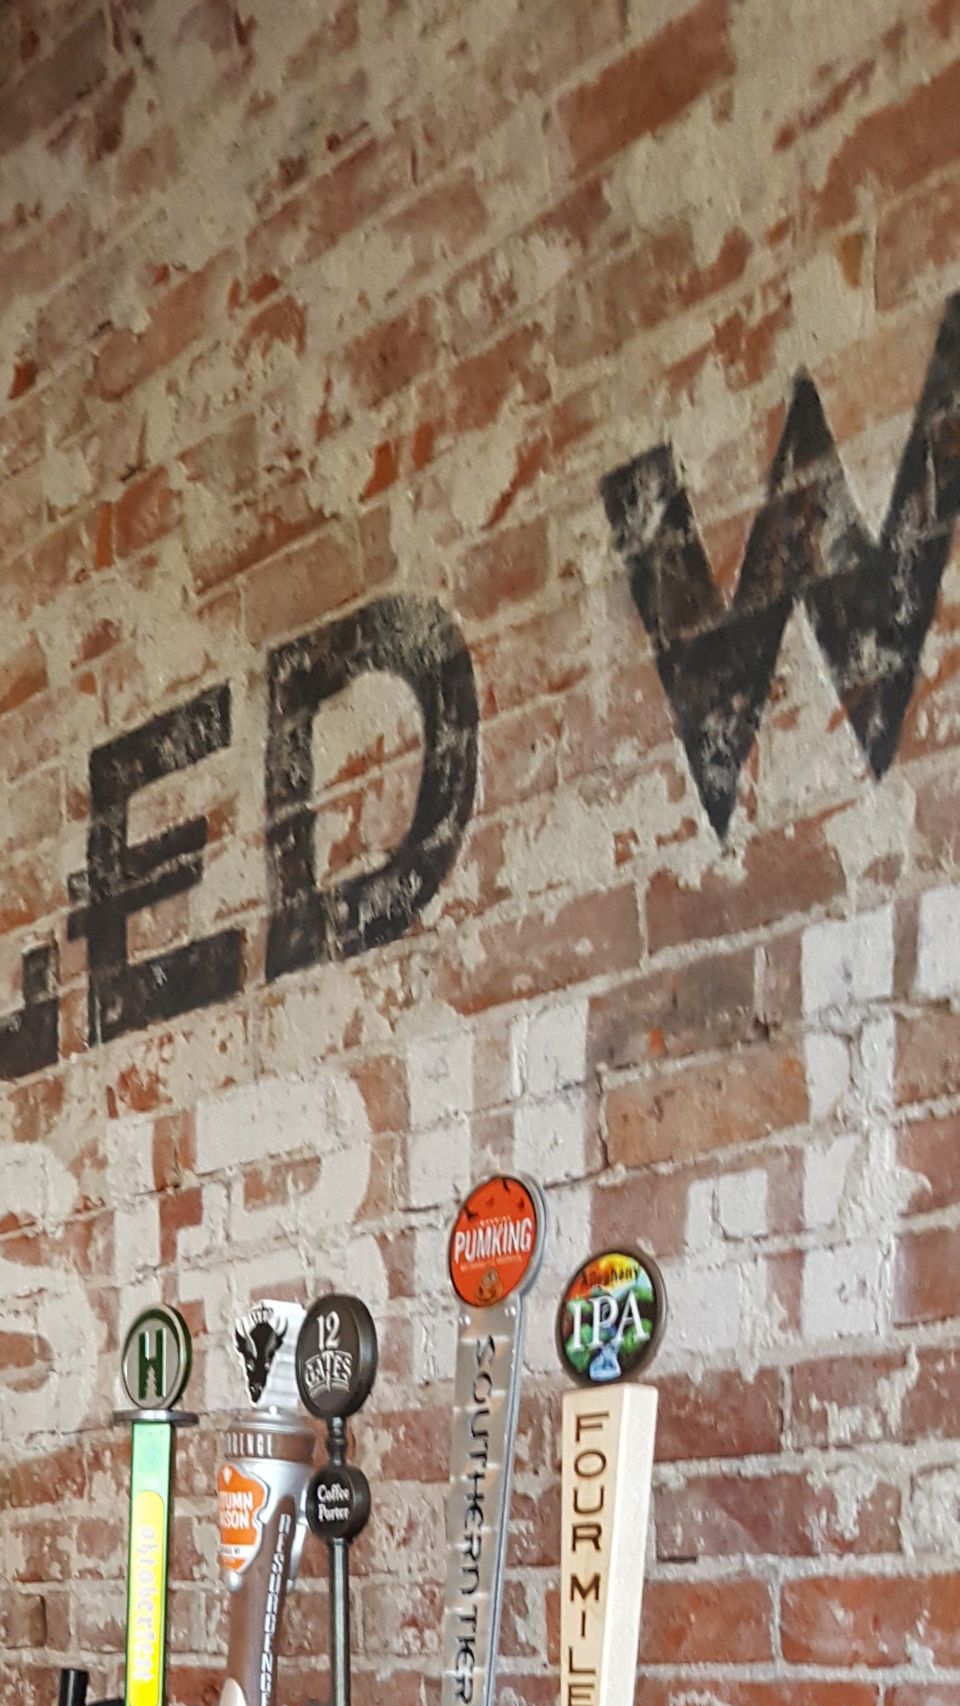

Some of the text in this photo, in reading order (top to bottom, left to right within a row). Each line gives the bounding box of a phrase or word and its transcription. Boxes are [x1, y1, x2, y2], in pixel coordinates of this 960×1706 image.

[454, 1217, 532, 1264] PUMKING
[317, 1310, 340, 1351] 12
[567, 1290, 650, 1351] IPA
[138, 1327, 167, 1399] H
[305, 1351, 352, 1391] GATES
[220, 1490, 253, 1511] TUMN
[317, 1483, 350, 1502] Coffee
[571, 1412, 609, 1552] FOUR
[220, 1510, 250, 1530] ISON
[317, 1503, 350, 1523] Porter
[454, 1335, 495, 1705] SOUTHERN TIER
[134, 1526, 159, 1681] oktoberfest
